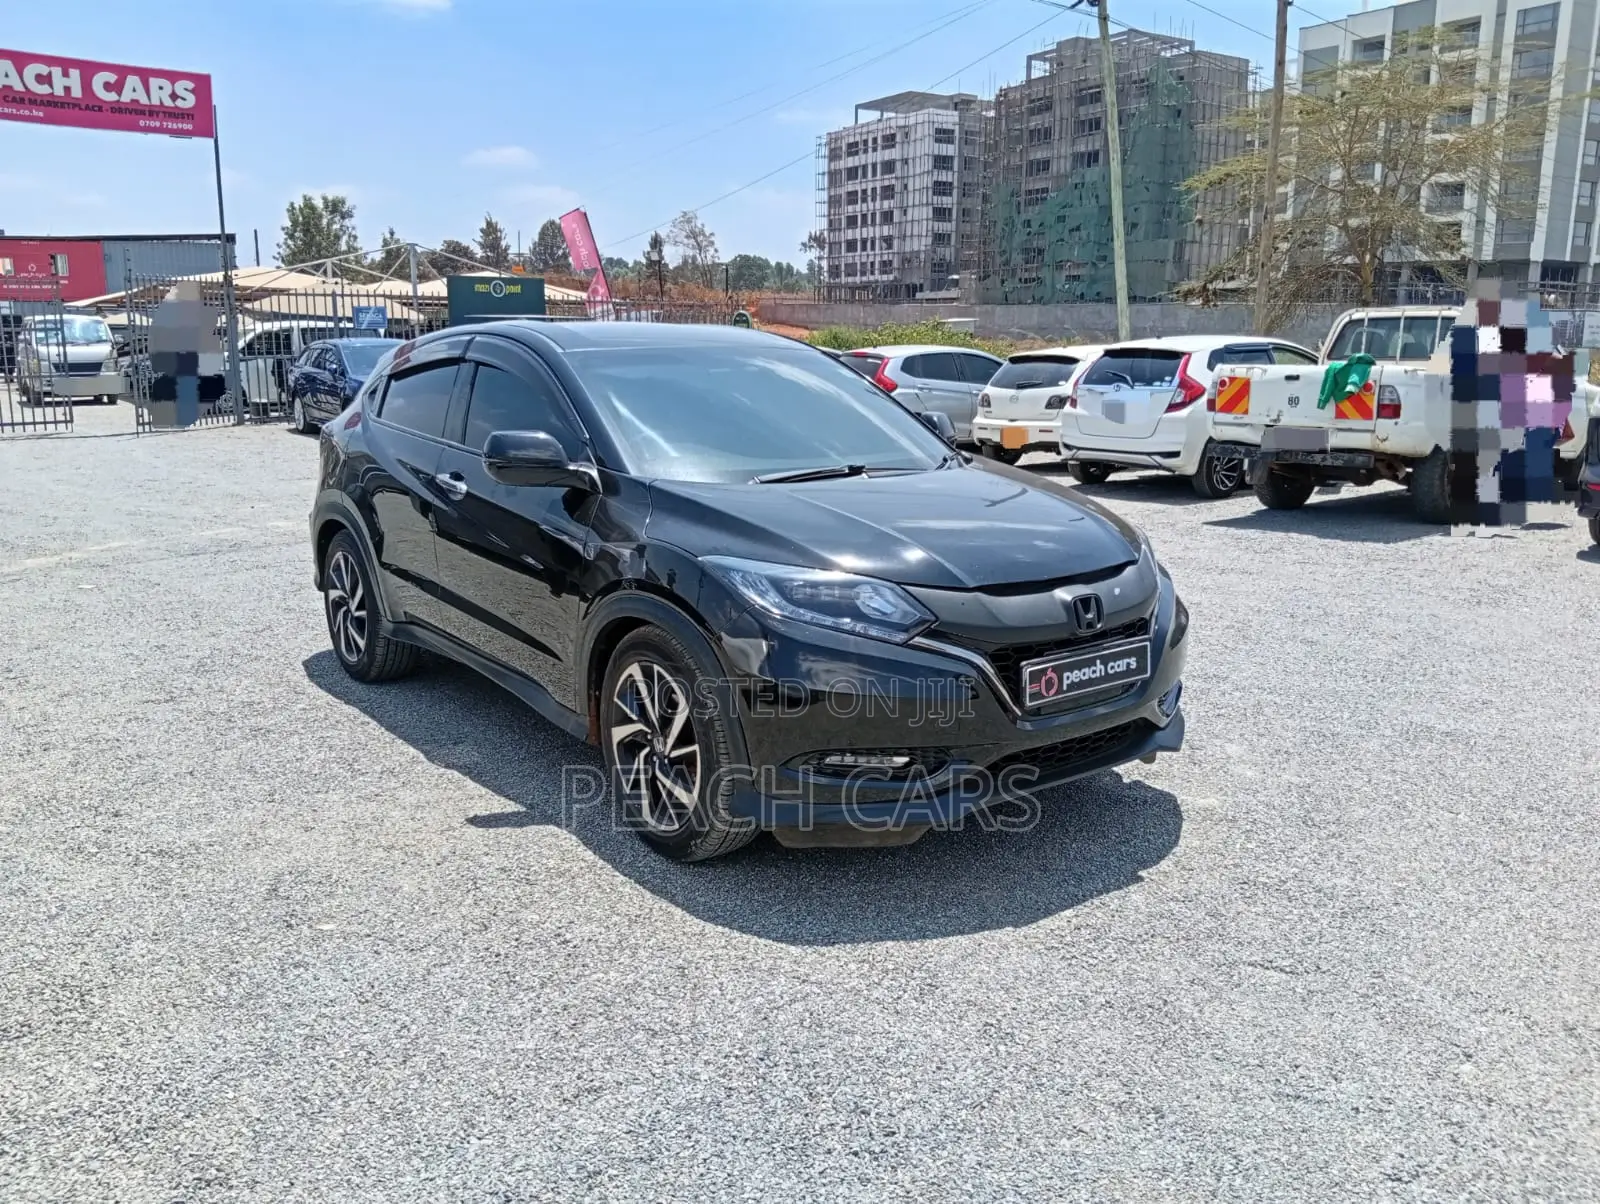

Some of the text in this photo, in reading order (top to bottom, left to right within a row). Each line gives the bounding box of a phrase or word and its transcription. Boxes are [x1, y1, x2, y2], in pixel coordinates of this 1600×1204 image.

[91, 71, 196, 109] CARS
[3, 94, 26, 105] CAR
[28, 97, 103, 112] MARKETPLACE
[110, 106, 146, 117] DRIVEN
[148, 109, 160, 118] BY
[139, 120, 160, 128] 0709
[1287, 396, 1300, 406] 80
[1063, 657, 1137, 691] peach cars
